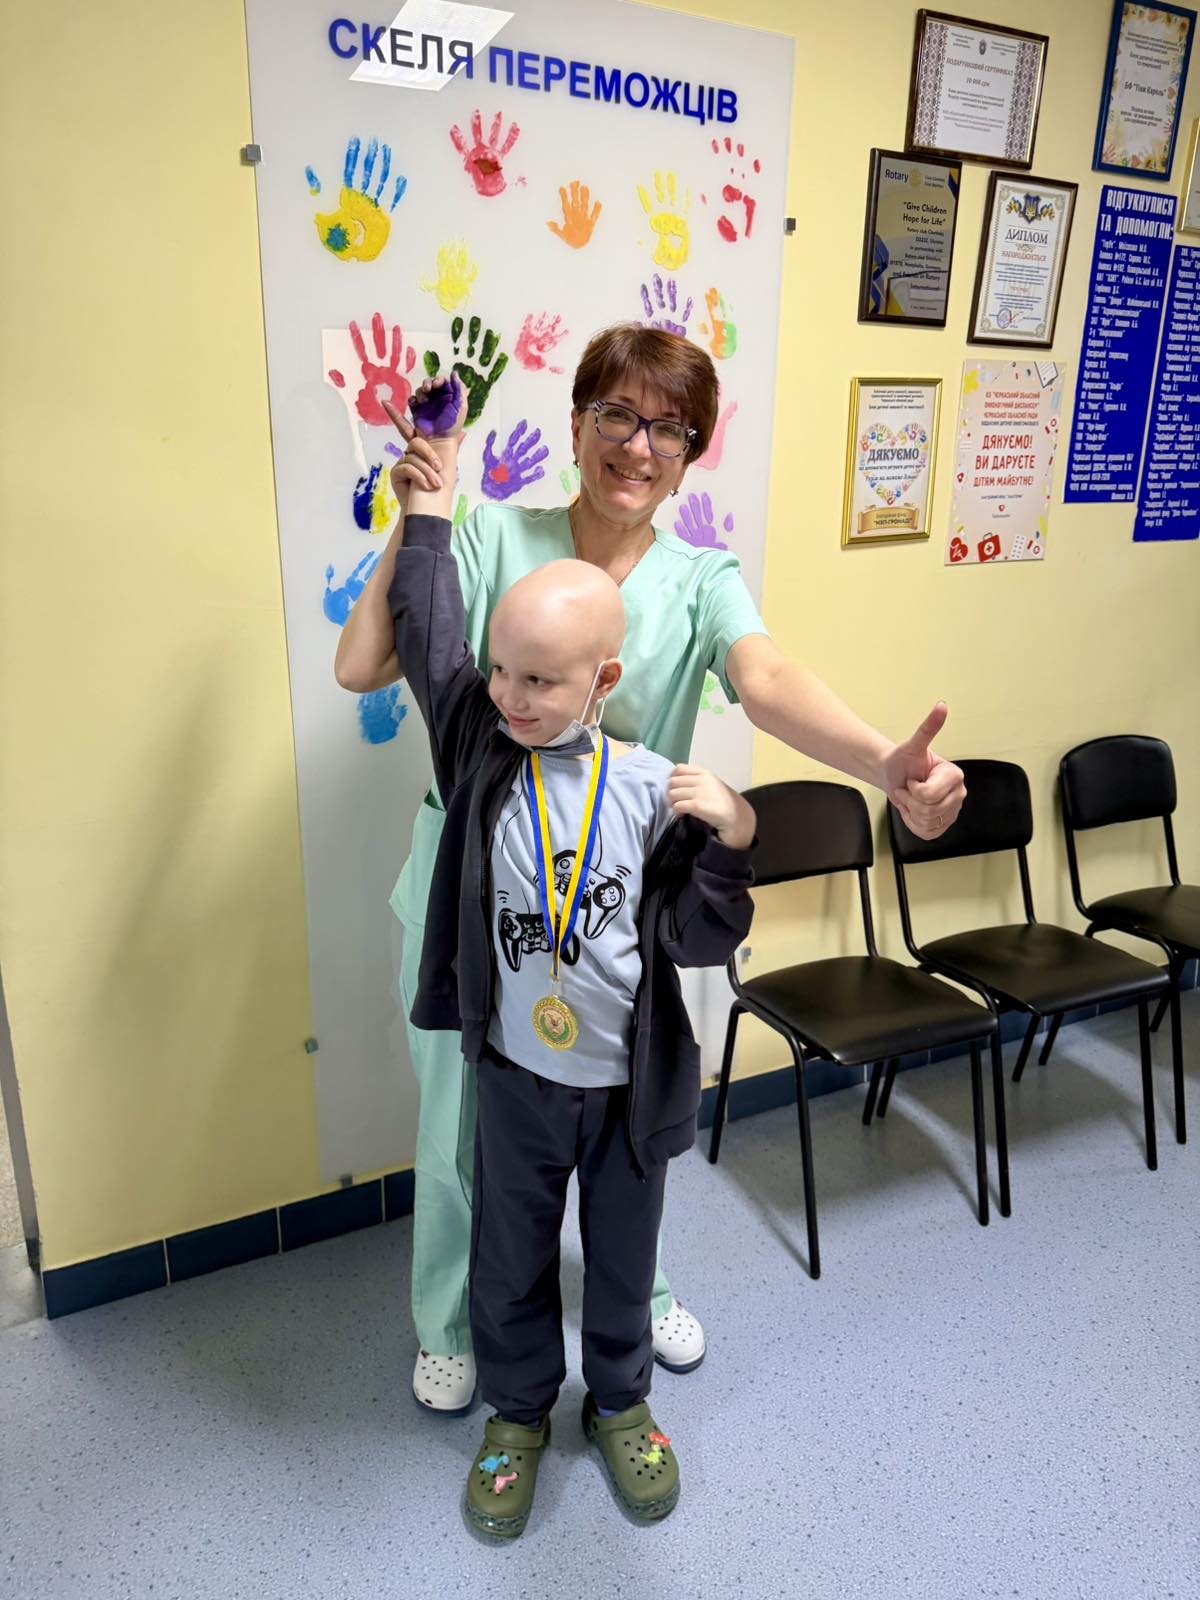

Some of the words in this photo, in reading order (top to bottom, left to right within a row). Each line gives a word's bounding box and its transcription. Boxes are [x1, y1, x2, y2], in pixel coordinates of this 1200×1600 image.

[327, 18, 473, 79] СКЕЛЯ
[489, 46, 738, 125] ПЕРЕМОЖЦІВ
[885, 168, 908, 183] Rotary
[904, 202, 919, 212] "Give
[922, 203, 947, 215] Children
[1106, 189, 1174, 216] ВІДГУКНУЛИСЯ
[902, 213, 919, 224] Hope
[920, 216, 930, 224] for
[931, 217, 946, 226] Life"
[1101, 214, 1112, 232] ТА
[1115, 216, 1174, 240] ДОПОМОГЛИ:
[1005, 228, 1049, 244] ДИПЛОМ
[982, 434, 1033, 450] ДЯКУЄМО!
[868, 448, 920, 464] ДЯКУЄМО
[975, 455, 989, 470] ВИ
[992, 455, 1036, 471] ДАРУЄТЕ
[973, 476, 995, 487] ДІТЯМ
